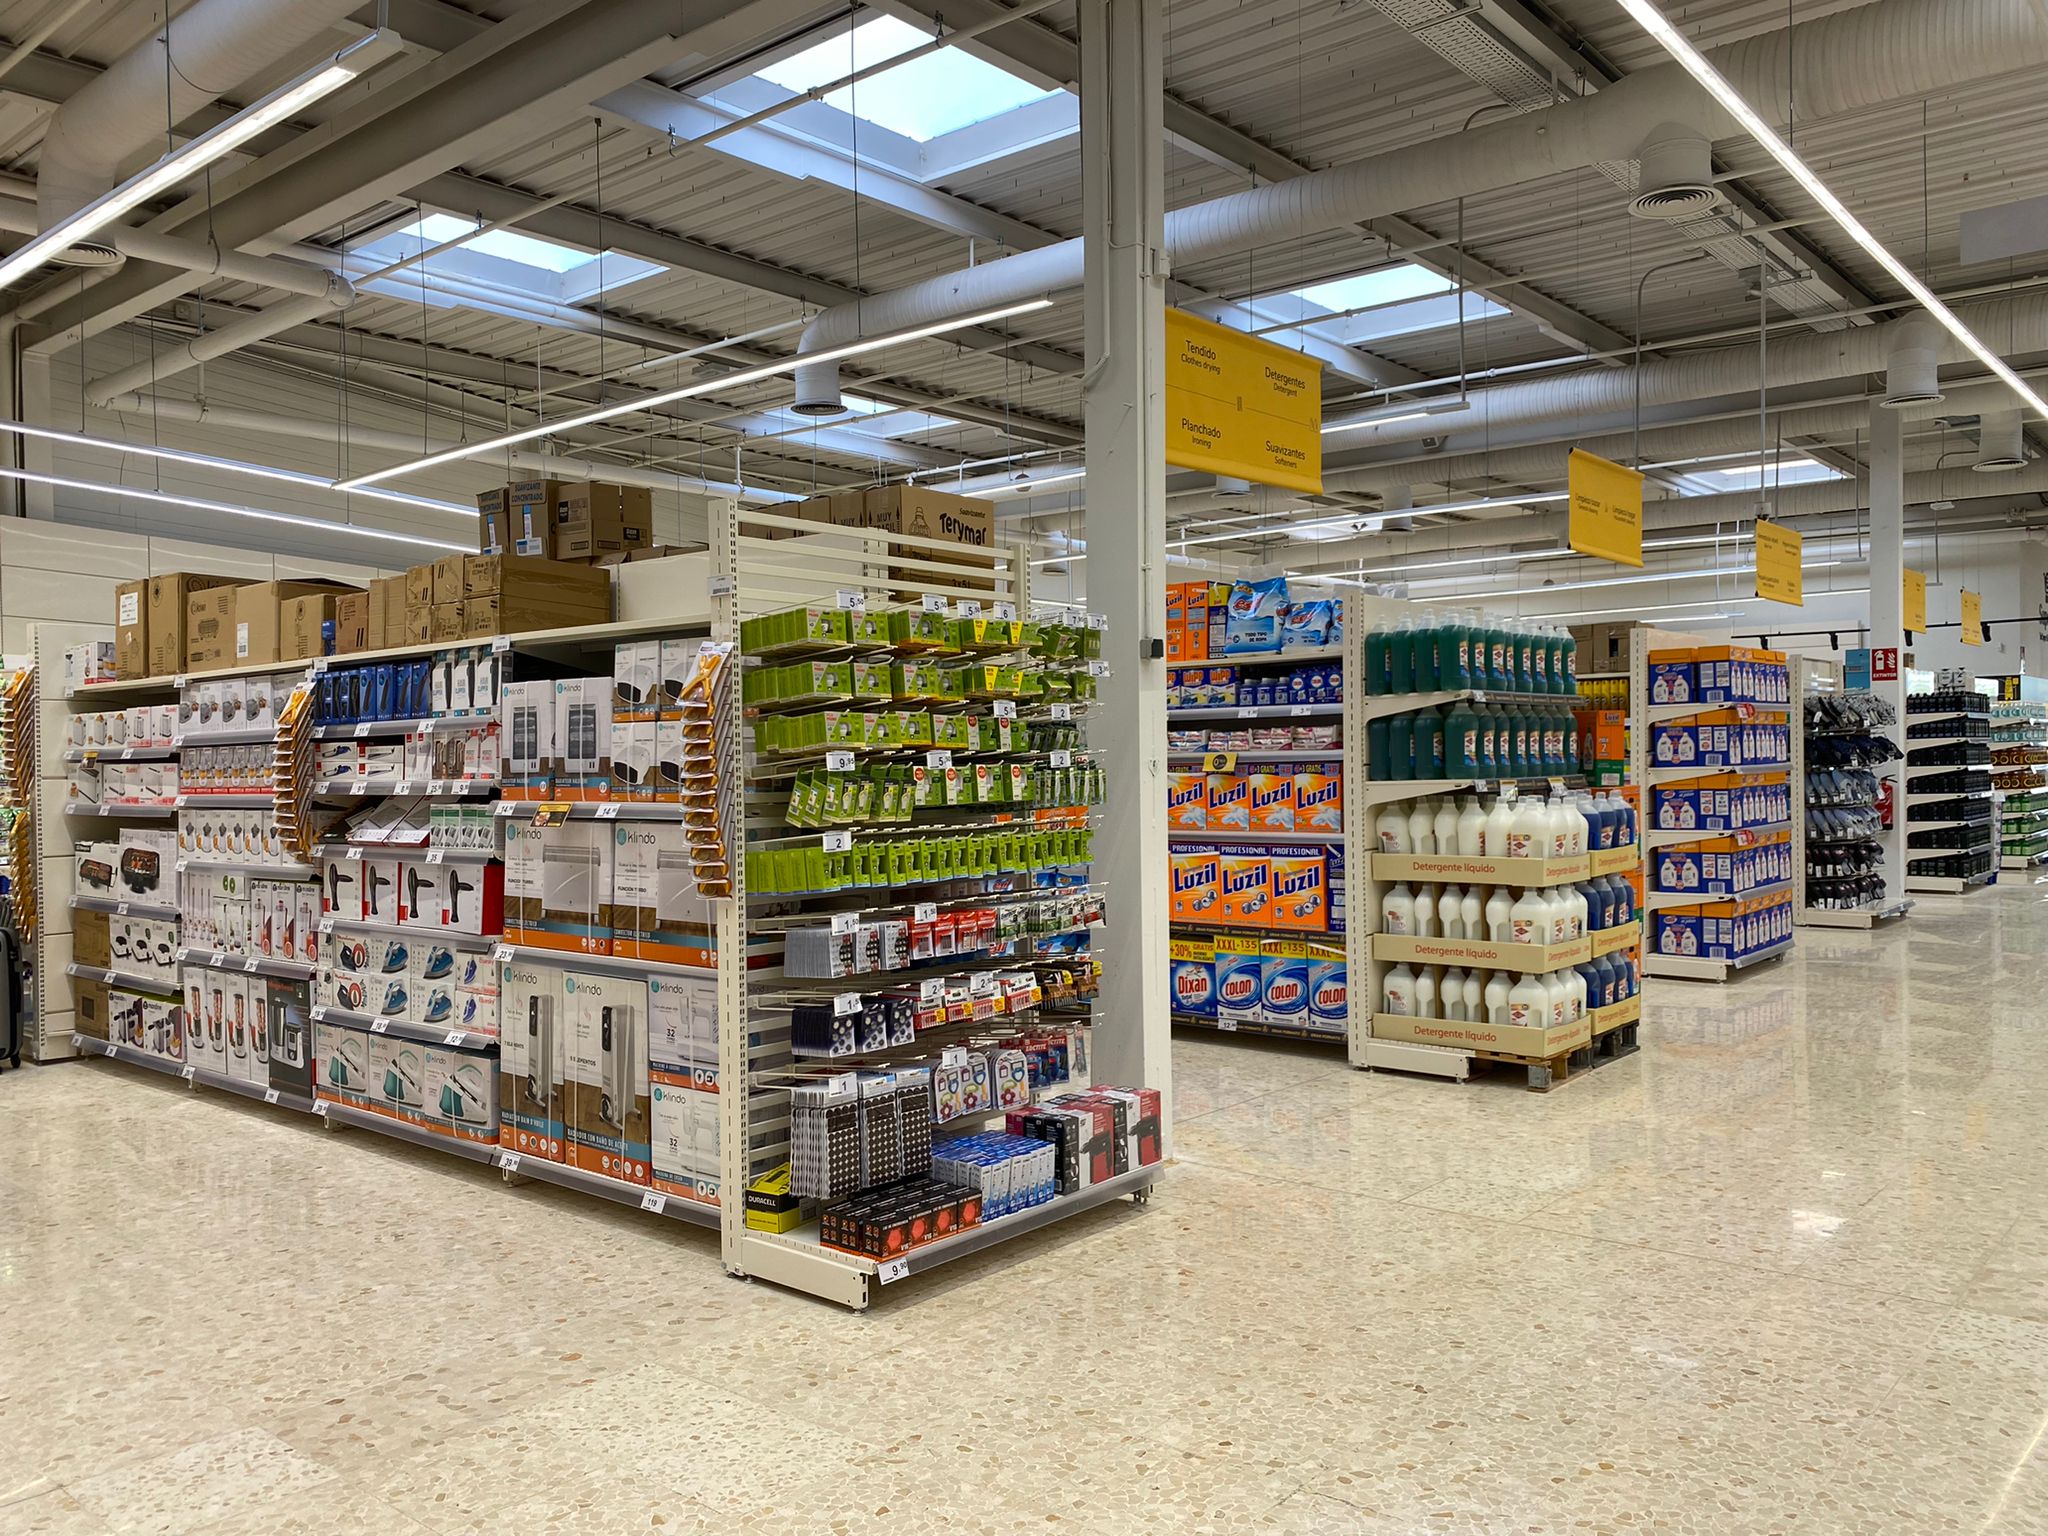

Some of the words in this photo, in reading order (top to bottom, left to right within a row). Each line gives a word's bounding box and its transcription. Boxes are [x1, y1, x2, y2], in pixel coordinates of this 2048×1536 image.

[1186, 340, 1216, 360] Tendido
[1181, 354, 1202, 368] Clothes
[1203, 361, 1221, 375] drying
[1265, 366, 1305, 390] Detergentes
[1274, 383, 1297, 397] Detergent
[1182, 418, 1221, 439] Planchado
[1192, 436, 1211, 449] Ironing
[1265, 441, 1305, 461] Suavizantes
[877, 512, 892, 522] MUY
[960, 508, 986, 518] Suavizante
[940, 513, 987, 545] Terymar
[1002, 609, 1008, 618] 6
[563, 684, 582, 693] klindo
[1168, 782, 1203, 809] Luzil
[1209, 781, 1247, 809] Luzil
[1252, 781, 1291, 809] Luzil
[1297, 780, 1338, 810] Luzil
[517, 828, 542, 840] klindo
[628, 828, 656, 845] klindo
[835, 838, 842, 848] 2
[1172, 844, 1215, 852] PROFESIONAL
[1221, 846, 1268, 855] PROFESIONAL
[1272, 847, 1320, 856] PROFESIONAL
[1412, 862, 1463, 874] Detergente
[1464, 863, 1496, 875] líquido
[1174, 862, 1216, 893] Luzil
[1223, 864, 1267, 895] Luzil
[1273, 866, 1320, 898] Luzil
[1170, 943, 1192, 958] +30%
[1192, 943, 1214, 951] GRATIS
[1415, 944, 1464, 958] Detergente
[1466, 946, 1498, 960] líquido
[513, 969, 537, 984] klindo
[577, 982, 602, 996] klindo
[660, 983, 683, 994] klindo
[1177, 975, 1208, 994] Dixan
[1225, 979, 1252, 996] COLON
[1270, 983, 1298, 1000] COLON
[1318, 988, 1346, 1004] COLON
[666, 1028, 675, 1038] 32
[1414, 1026, 1464, 1040] Detergente
[1464, 1028, 1497, 1042] líquido
[1026, 1043, 1047, 1053] LOCTITE
[842, 1080, 847, 1092] 1
[664, 1092, 686, 1104] klindo
[587, 1132, 596, 1141] CON
[669, 1138, 678, 1147] 32
[647, 1198, 658, 1208] 119
[748, 1196, 776, 1207] DURACELL
